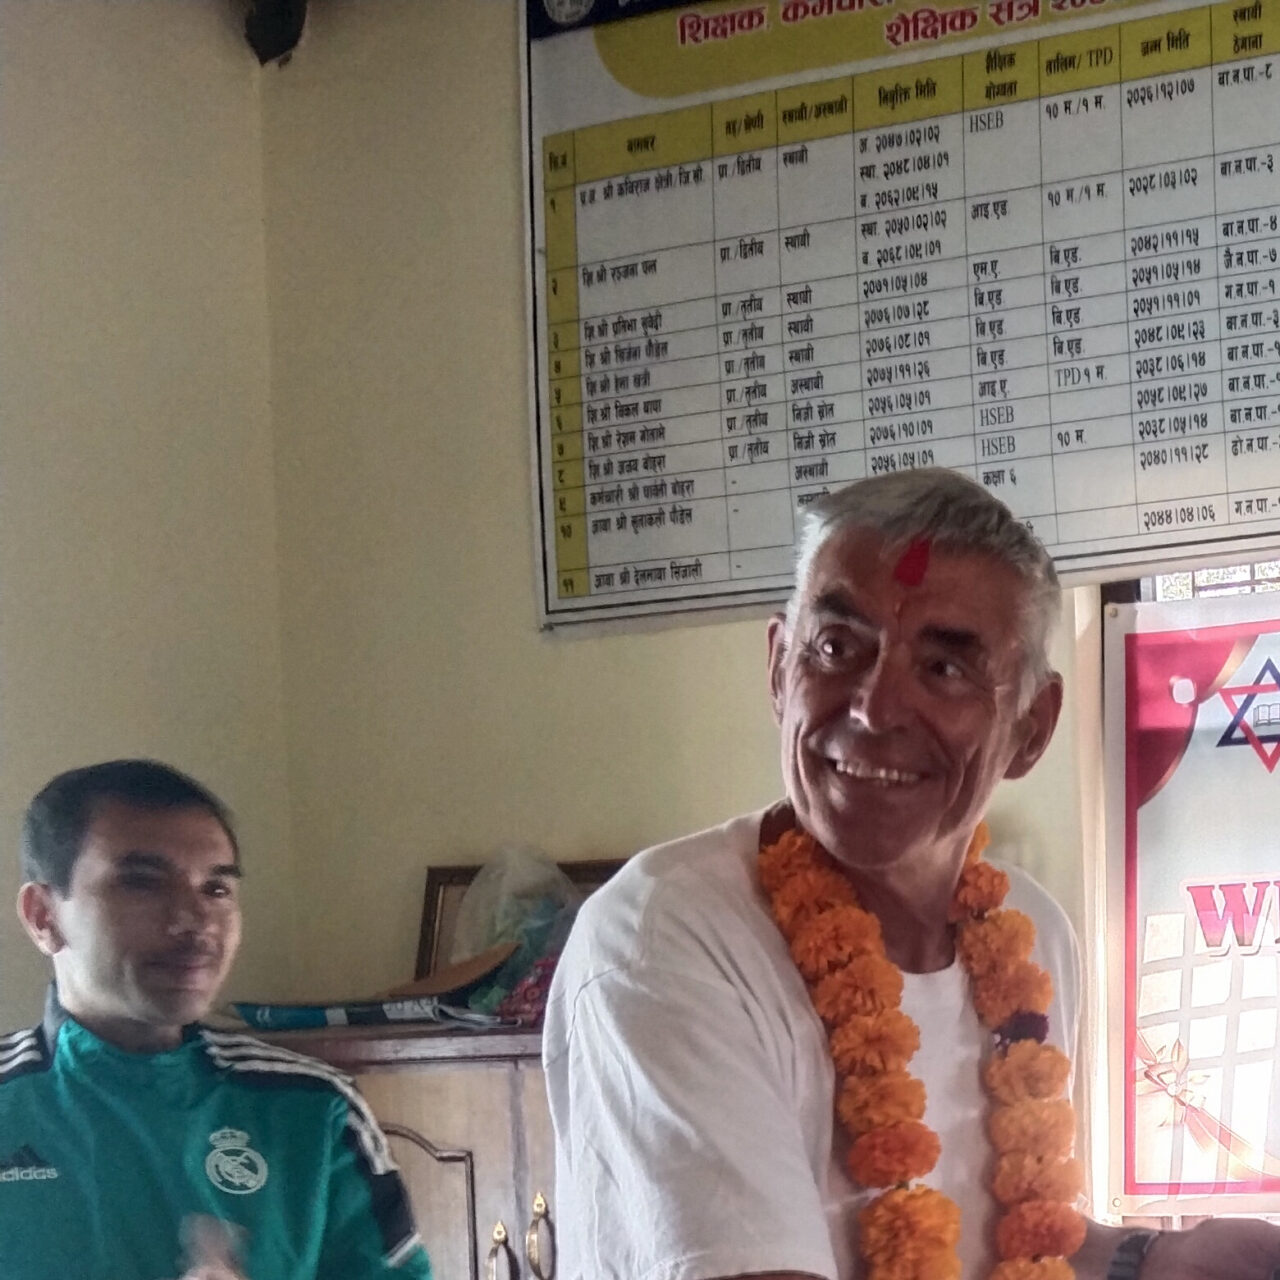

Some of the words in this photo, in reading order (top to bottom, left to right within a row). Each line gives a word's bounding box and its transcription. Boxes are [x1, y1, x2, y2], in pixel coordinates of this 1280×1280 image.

[1088, 47, 1113, 67] TPD
[969, 111, 1003, 132] HSEB
[1057, 367, 1081, 386] TPD
[980, 405, 1013, 426] HSEB
[981, 435, 1015, 456] HSEB
[0, 1167, 58, 1182] didas
